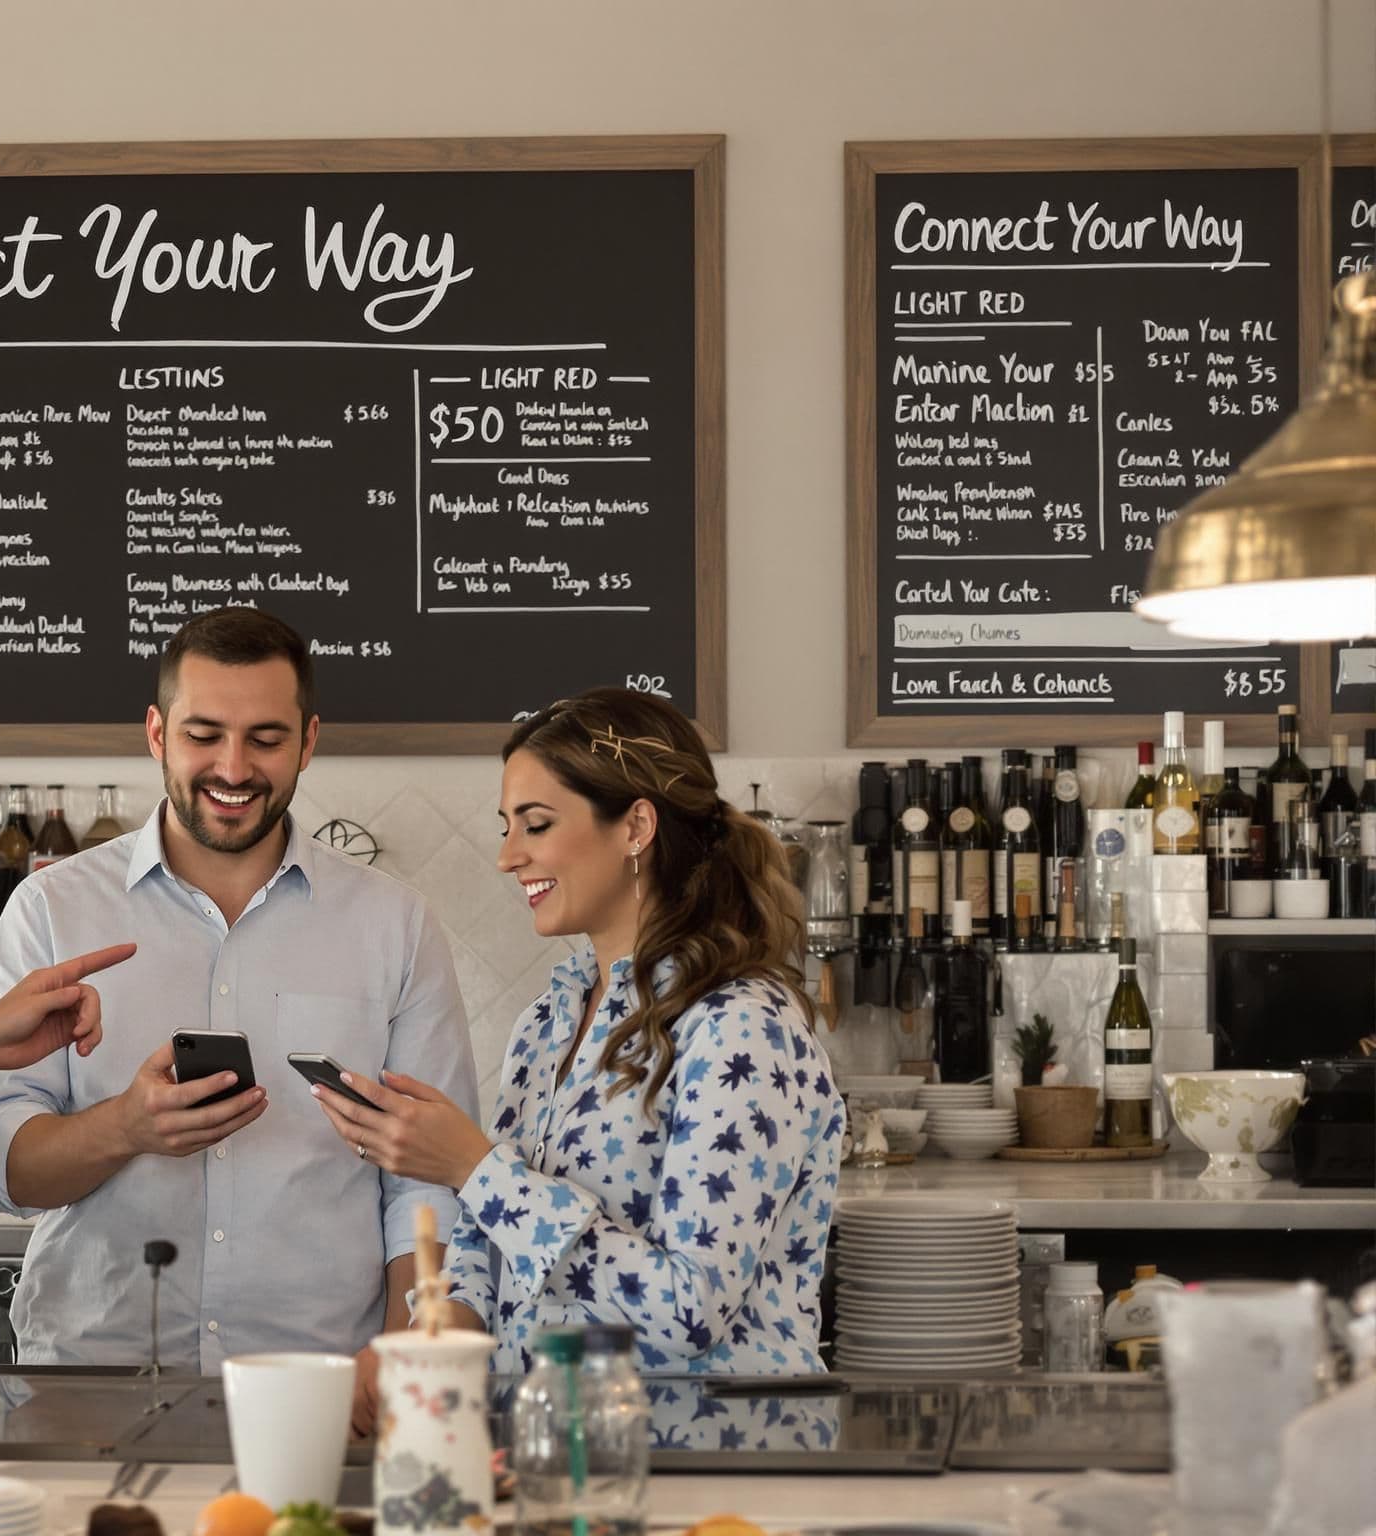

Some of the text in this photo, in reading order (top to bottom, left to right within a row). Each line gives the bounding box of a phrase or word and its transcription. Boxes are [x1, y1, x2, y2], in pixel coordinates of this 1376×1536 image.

[895, 200, 1243, 272] Connect Your Way
[79, 204, 275, 332] Your
[305, 203, 473, 332] Way
[895, 290, 1024, 315] LIGHT RED
[481, 367, 597, 391] LIGHT RED
[999, 352, 1054, 383] Your
[430, 403, 504, 449] $50
